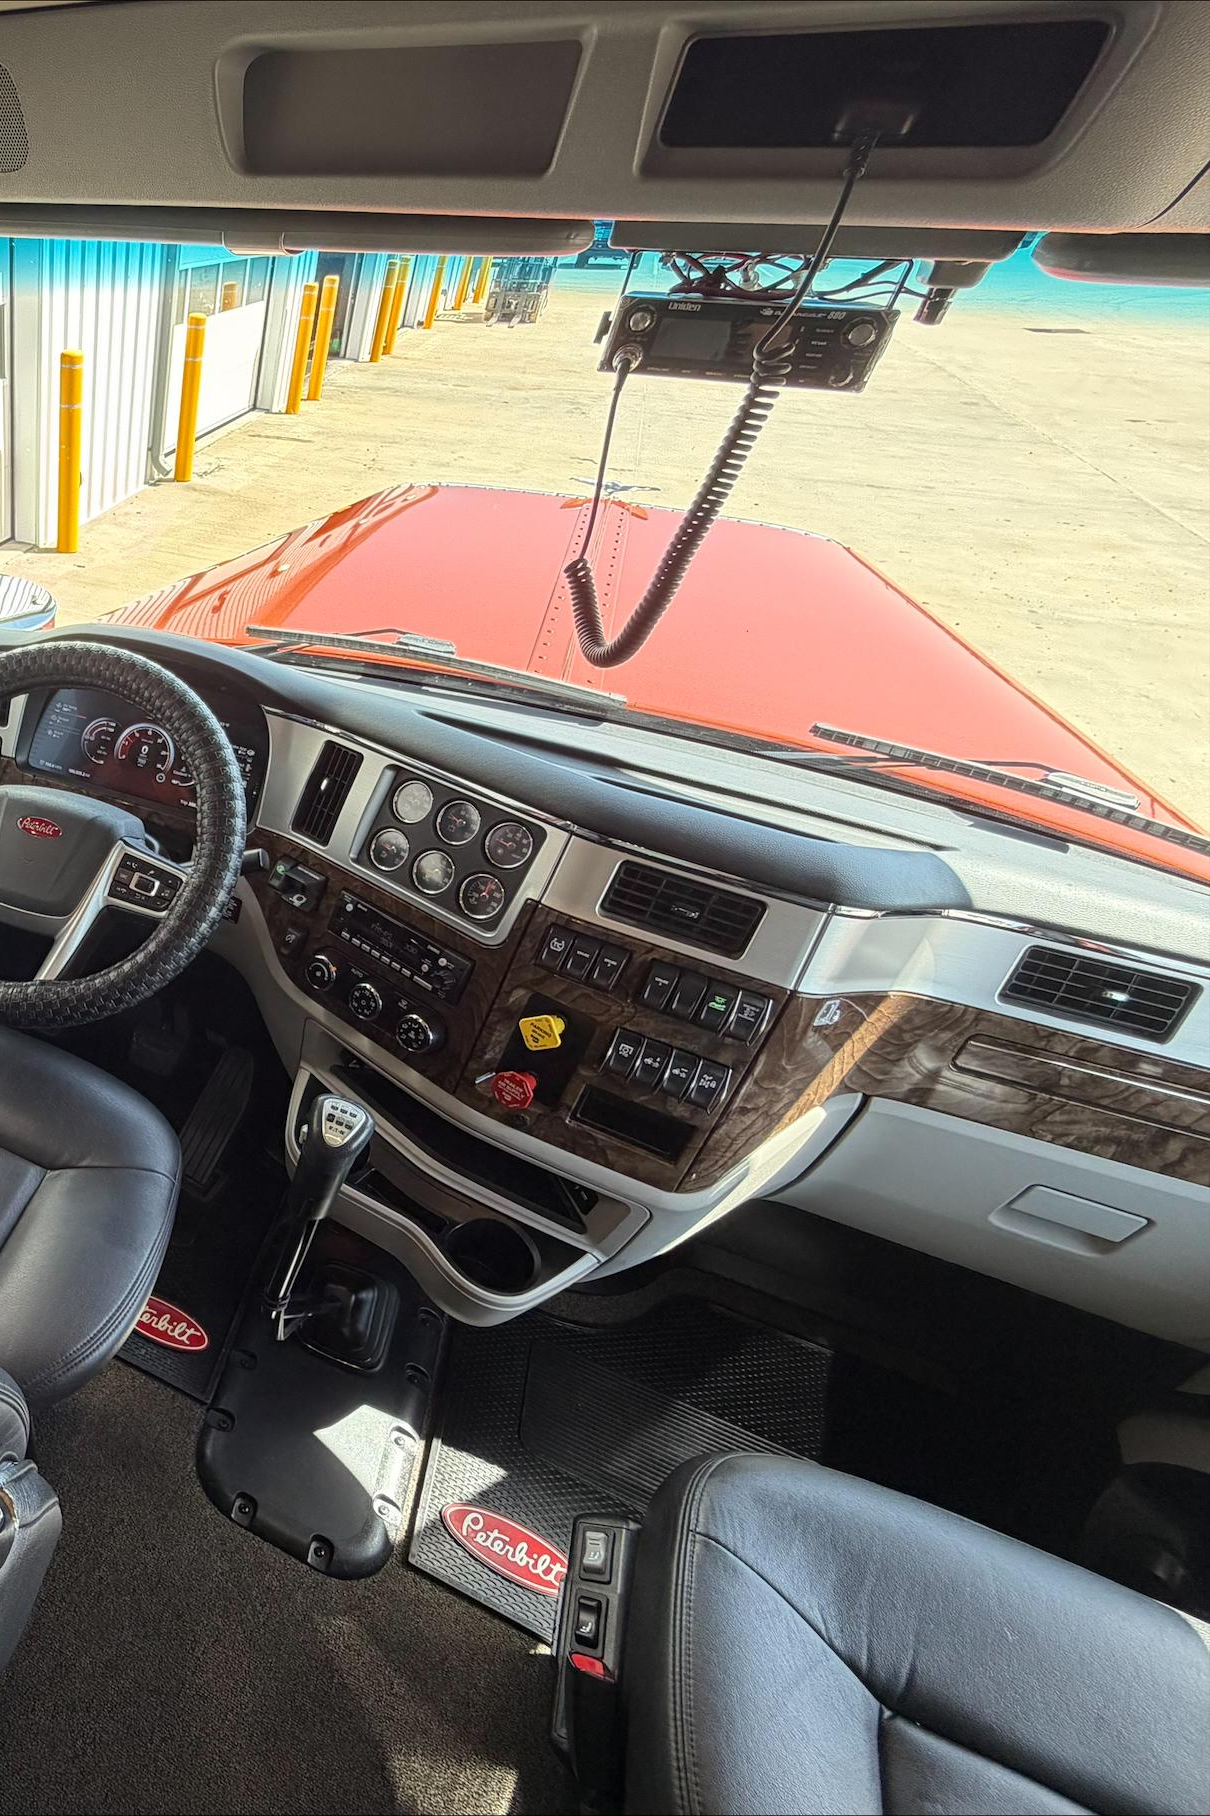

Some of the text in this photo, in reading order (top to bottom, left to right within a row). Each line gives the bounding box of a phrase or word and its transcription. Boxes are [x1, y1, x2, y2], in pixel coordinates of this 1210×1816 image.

[668, 301, 702, 312] Uniden
[530, 1022, 552, 1038] PARKING
[462, 1512, 567, 1586] Peterbilt
